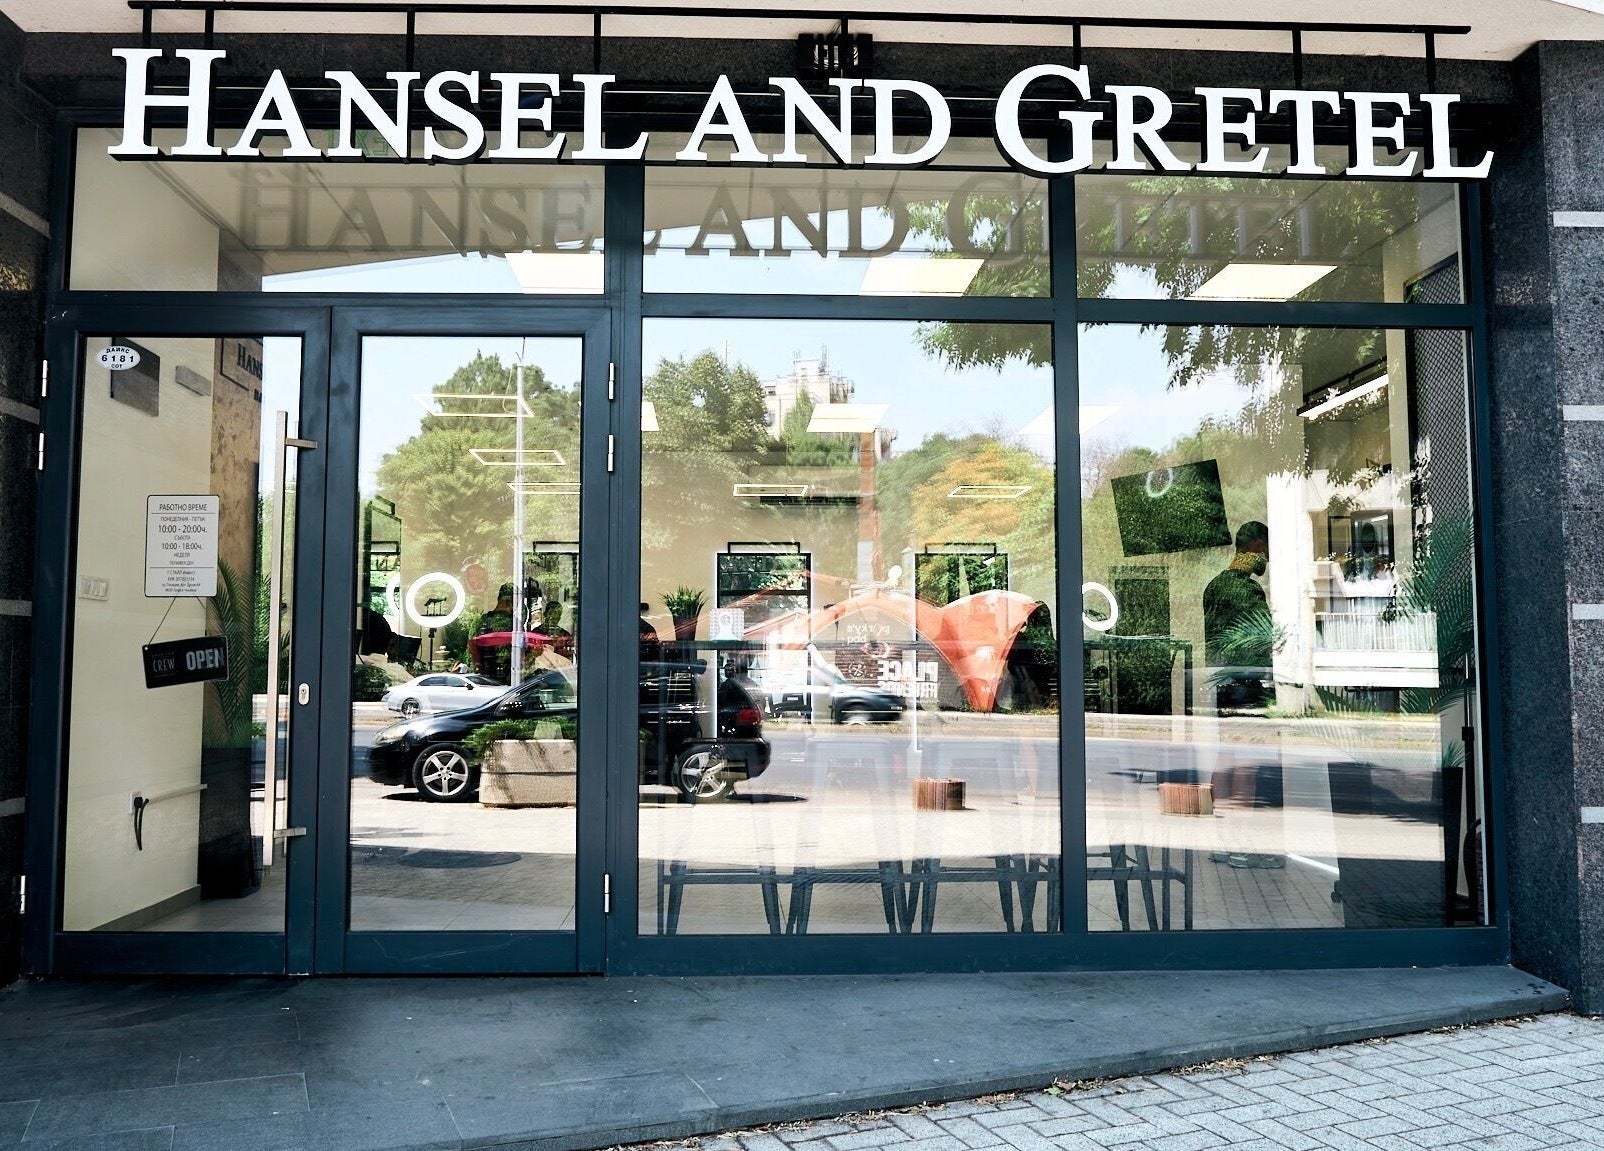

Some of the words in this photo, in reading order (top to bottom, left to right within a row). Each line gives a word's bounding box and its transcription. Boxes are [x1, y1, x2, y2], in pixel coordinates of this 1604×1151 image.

[108, 48, 649, 161] HANSEL
[676, 75, 951, 165] AND
[994, 64, 1495, 179] GRETEL
[101, 354, 134, 363] 6181
[159, 503, 187, 511] РАБОТНО
[188, 503, 207, 511] ВРЕМЕ
[158, 525, 177, 533] 10:00
[152, 658, 175, 672] CREW
[185, 648, 225, 670] OPEN
